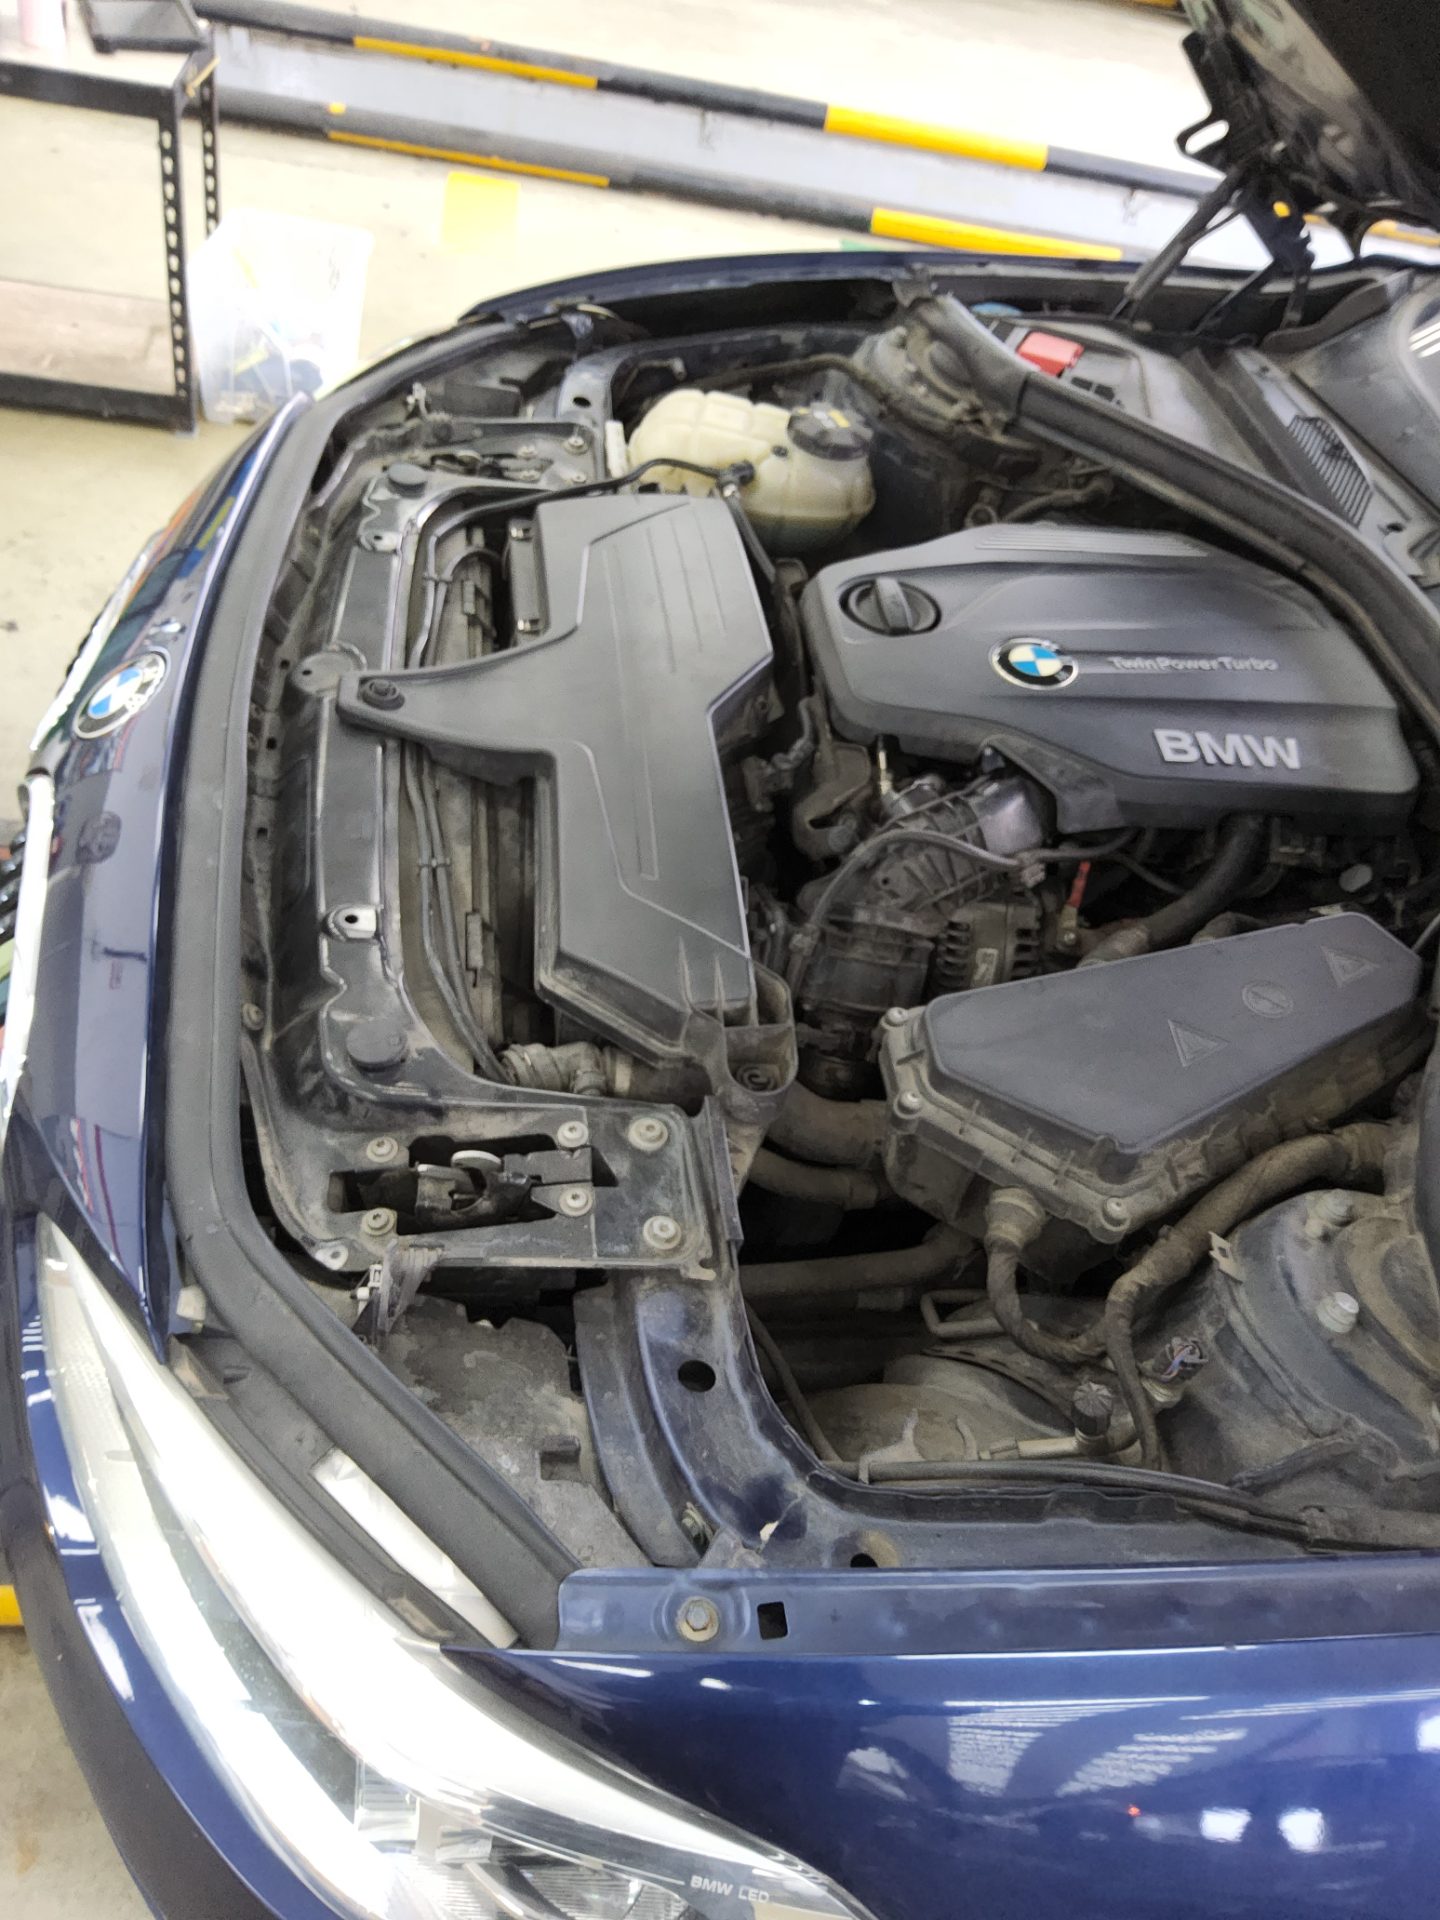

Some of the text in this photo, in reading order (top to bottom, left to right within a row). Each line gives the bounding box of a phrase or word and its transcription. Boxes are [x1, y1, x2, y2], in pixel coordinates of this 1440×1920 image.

[1153, 728, 1300, 770] BMW
[690, 1875, 769, 1903] BMW LED
